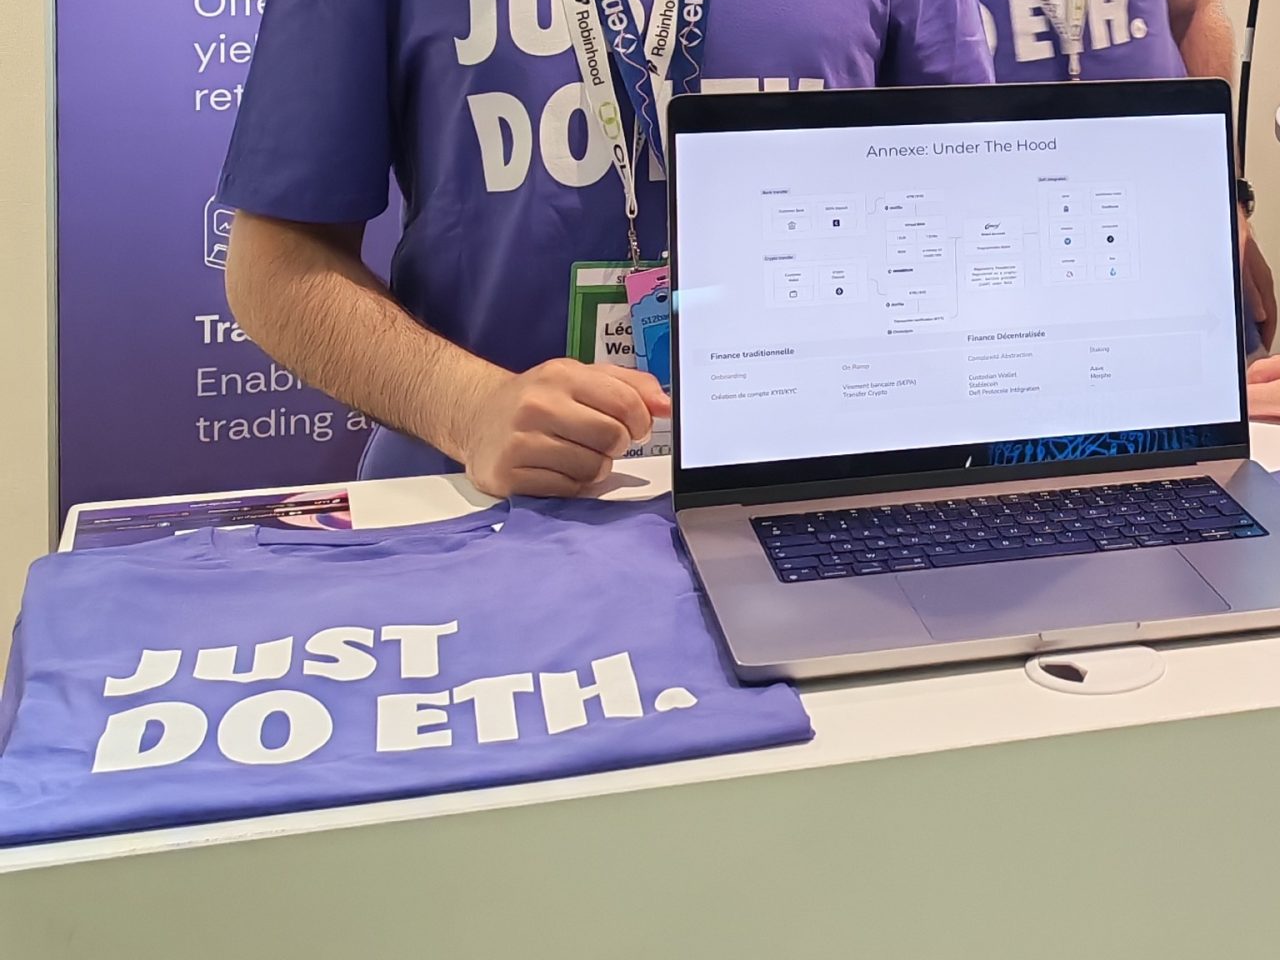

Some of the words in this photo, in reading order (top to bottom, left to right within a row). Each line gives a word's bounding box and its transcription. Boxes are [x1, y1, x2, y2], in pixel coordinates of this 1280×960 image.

[575, 9, 605, 87] Robinhood
[866, 143, 929, 159] Annexe:
[932, 141, 980, 156] Under
[984, 140, 1012, 153] The
[1016, 138, 1057, 152] Hood
[710, 351, 741, 360] Finance
[742, 347, 795, 358] traditionnelle
[967, 333, 995, 342] Finance
[195, 407, 334, 442] trading
[103, 620, 459, 697] JUST
[90, 689, 334, 774] DO
[375, 651, 699, 753] ETH.
